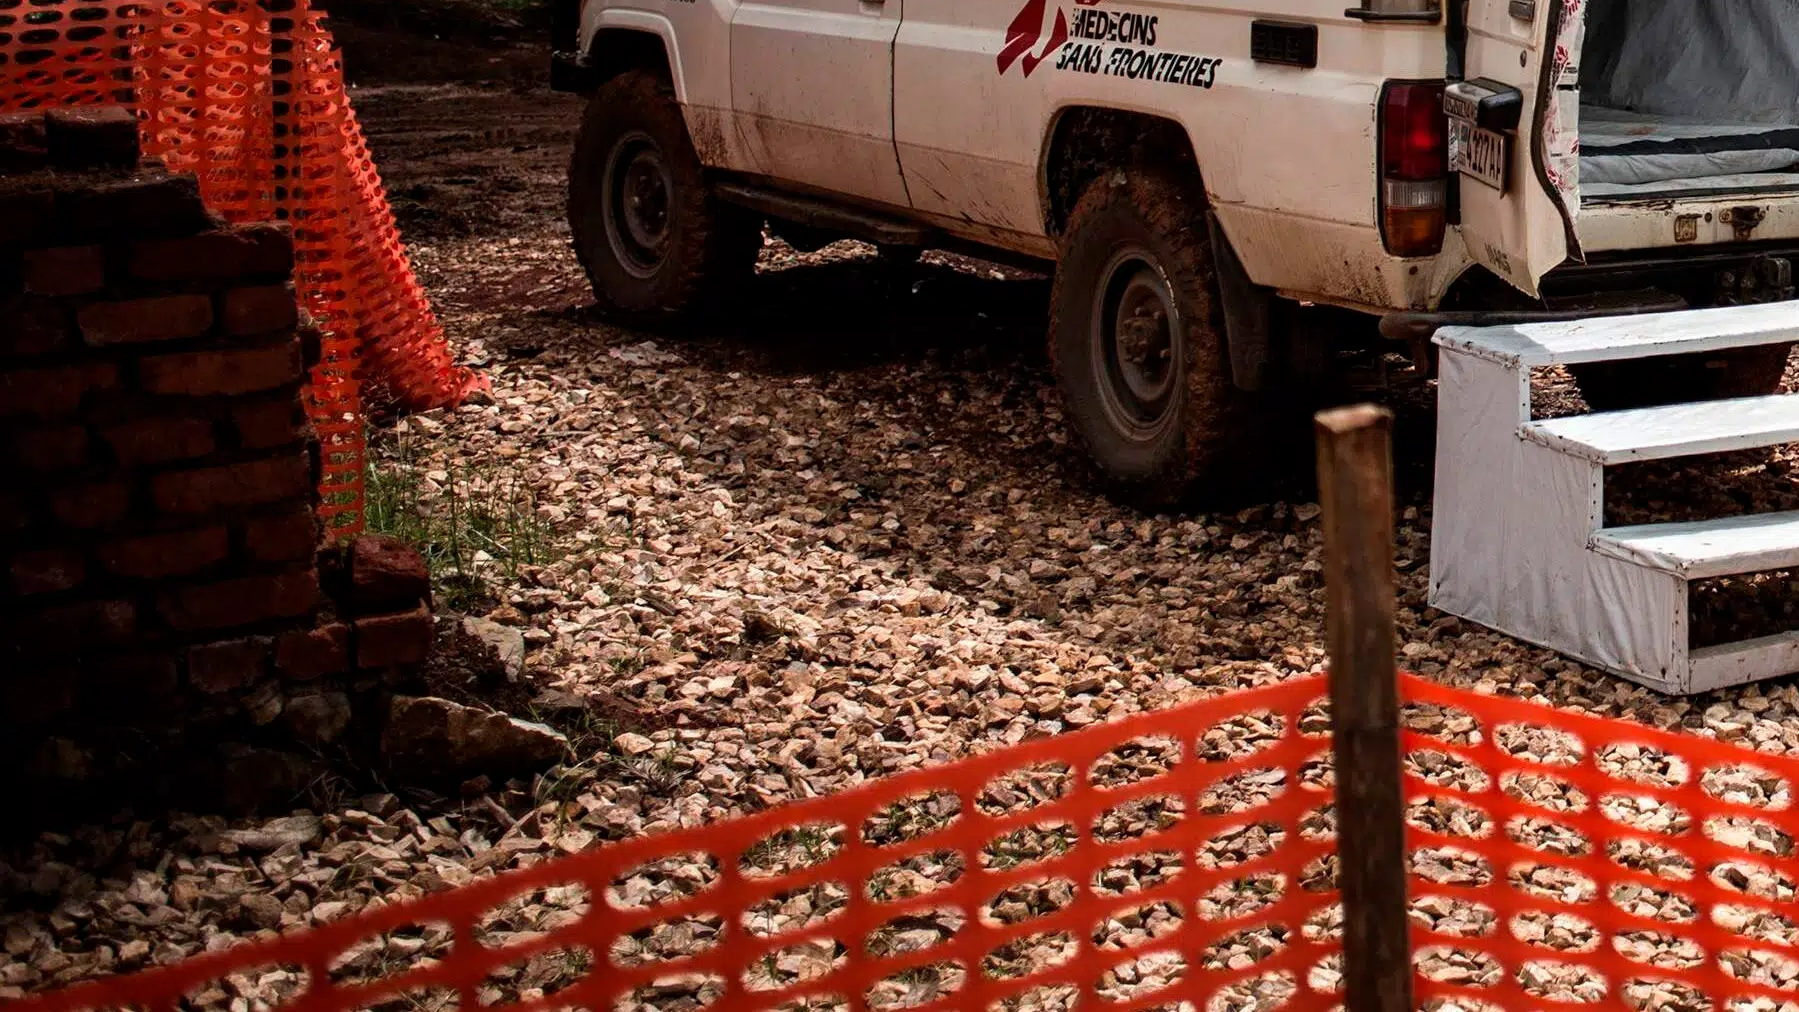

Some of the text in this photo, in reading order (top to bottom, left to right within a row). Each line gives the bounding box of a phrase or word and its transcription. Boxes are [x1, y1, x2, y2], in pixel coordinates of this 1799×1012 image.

[1070, 8, 1159, 46] MEDECINS
[1056, 42, 1222, 89] SANS FRONTIERES
